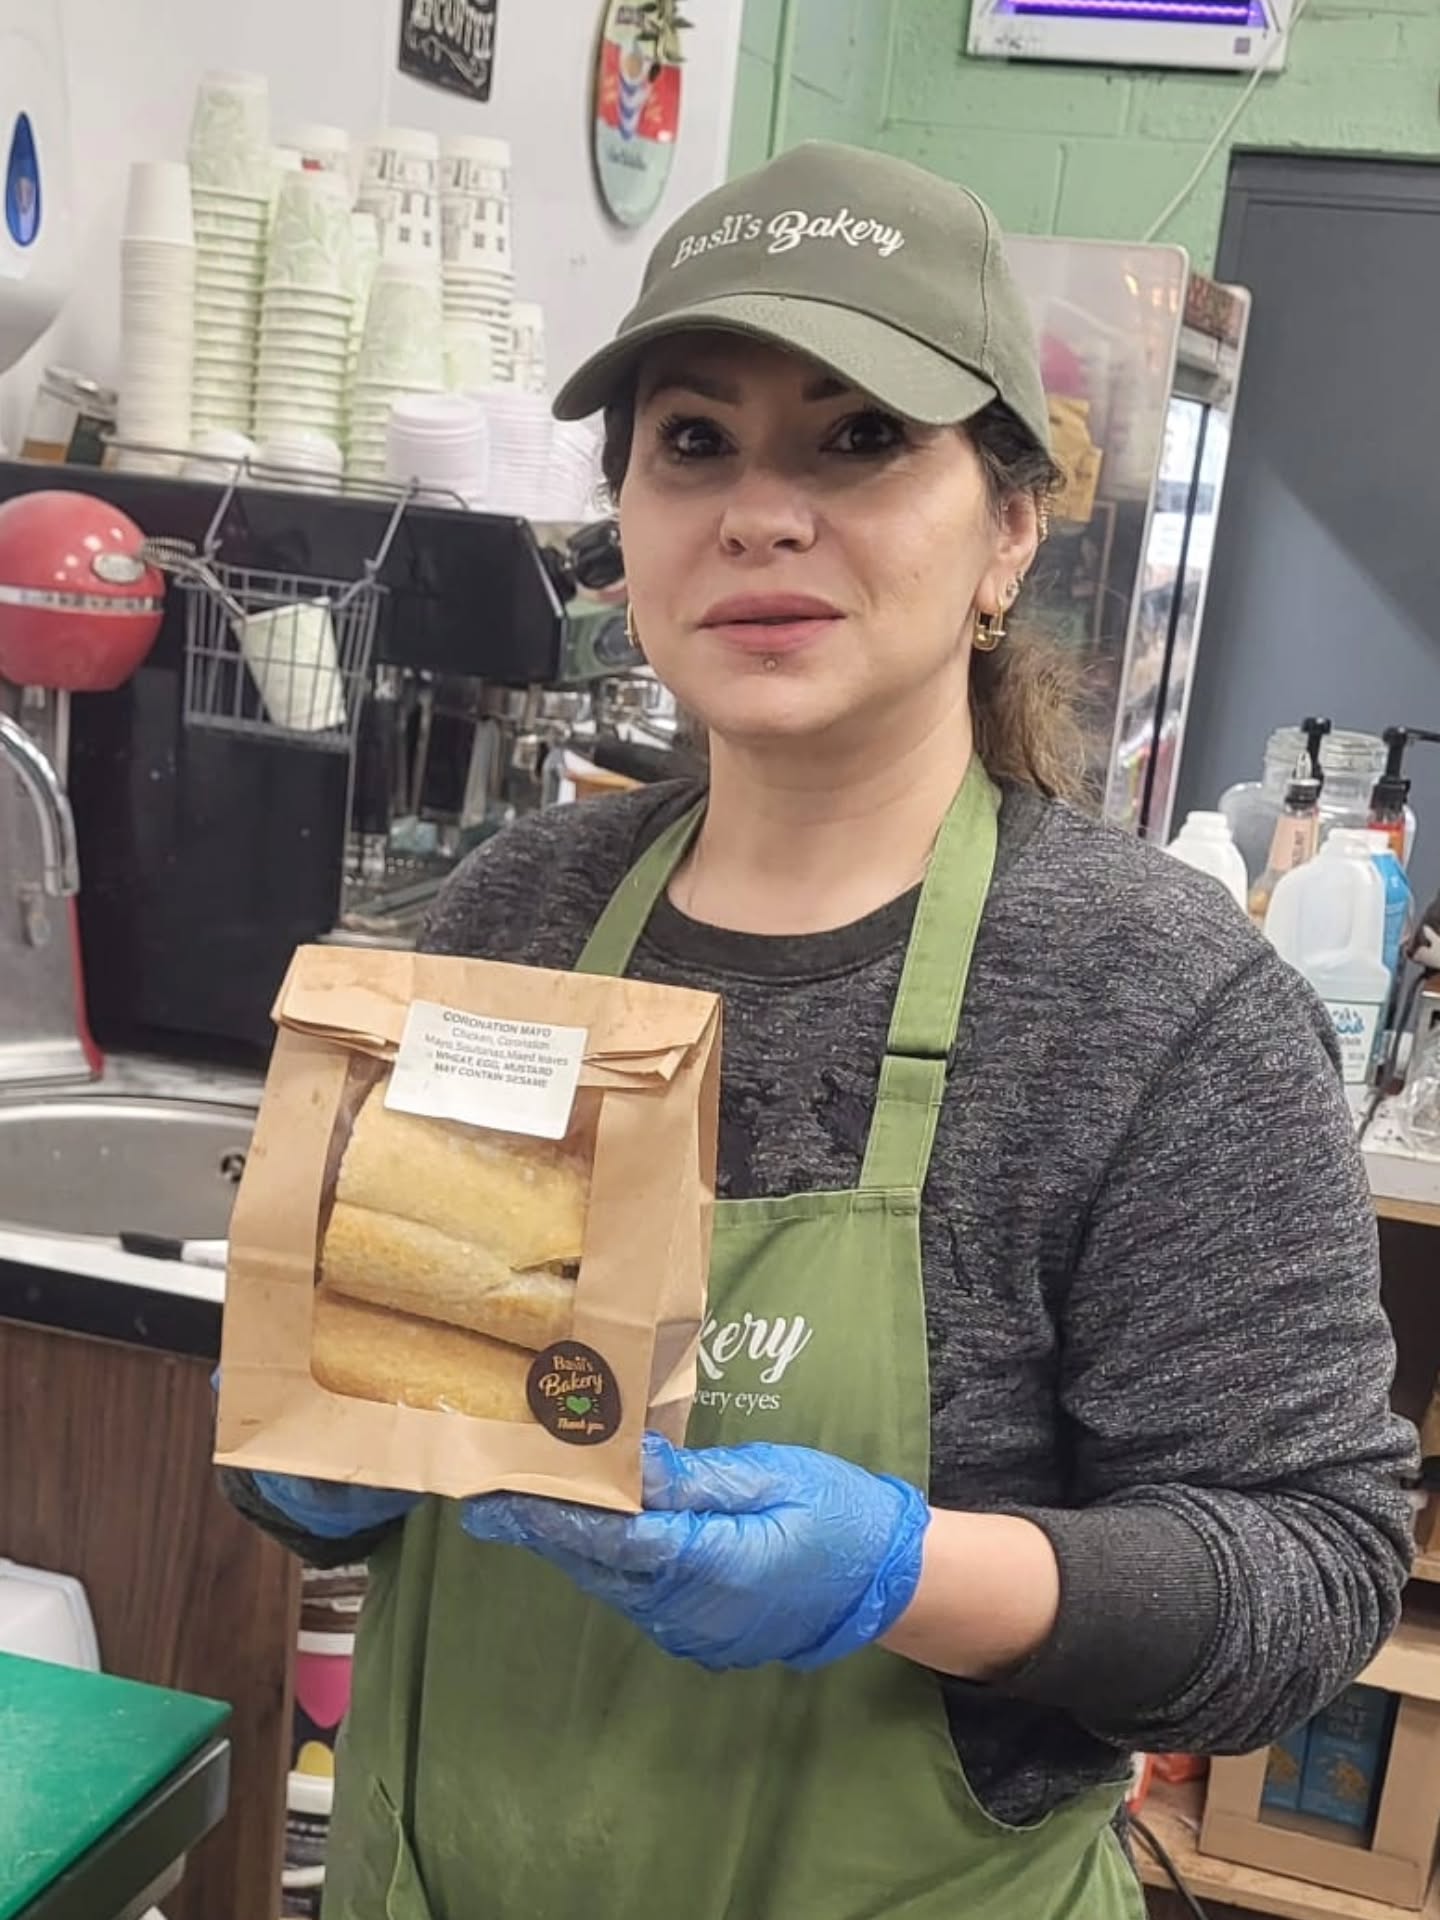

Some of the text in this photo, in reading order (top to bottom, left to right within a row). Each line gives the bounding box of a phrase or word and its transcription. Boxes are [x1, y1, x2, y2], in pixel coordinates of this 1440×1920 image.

[670, 207, 905, 268] Basil's Bakery
[442, 1011, 552, 1038] CORONATION MAYO
[434, 1061, 549, 1088] MAY CONTAIN SESAME
[503, 1062, 553, 1077] MUSTARD
[538, 1371, 603, 1397] Bakery
[734, 1391, 781, 1416] eyes
